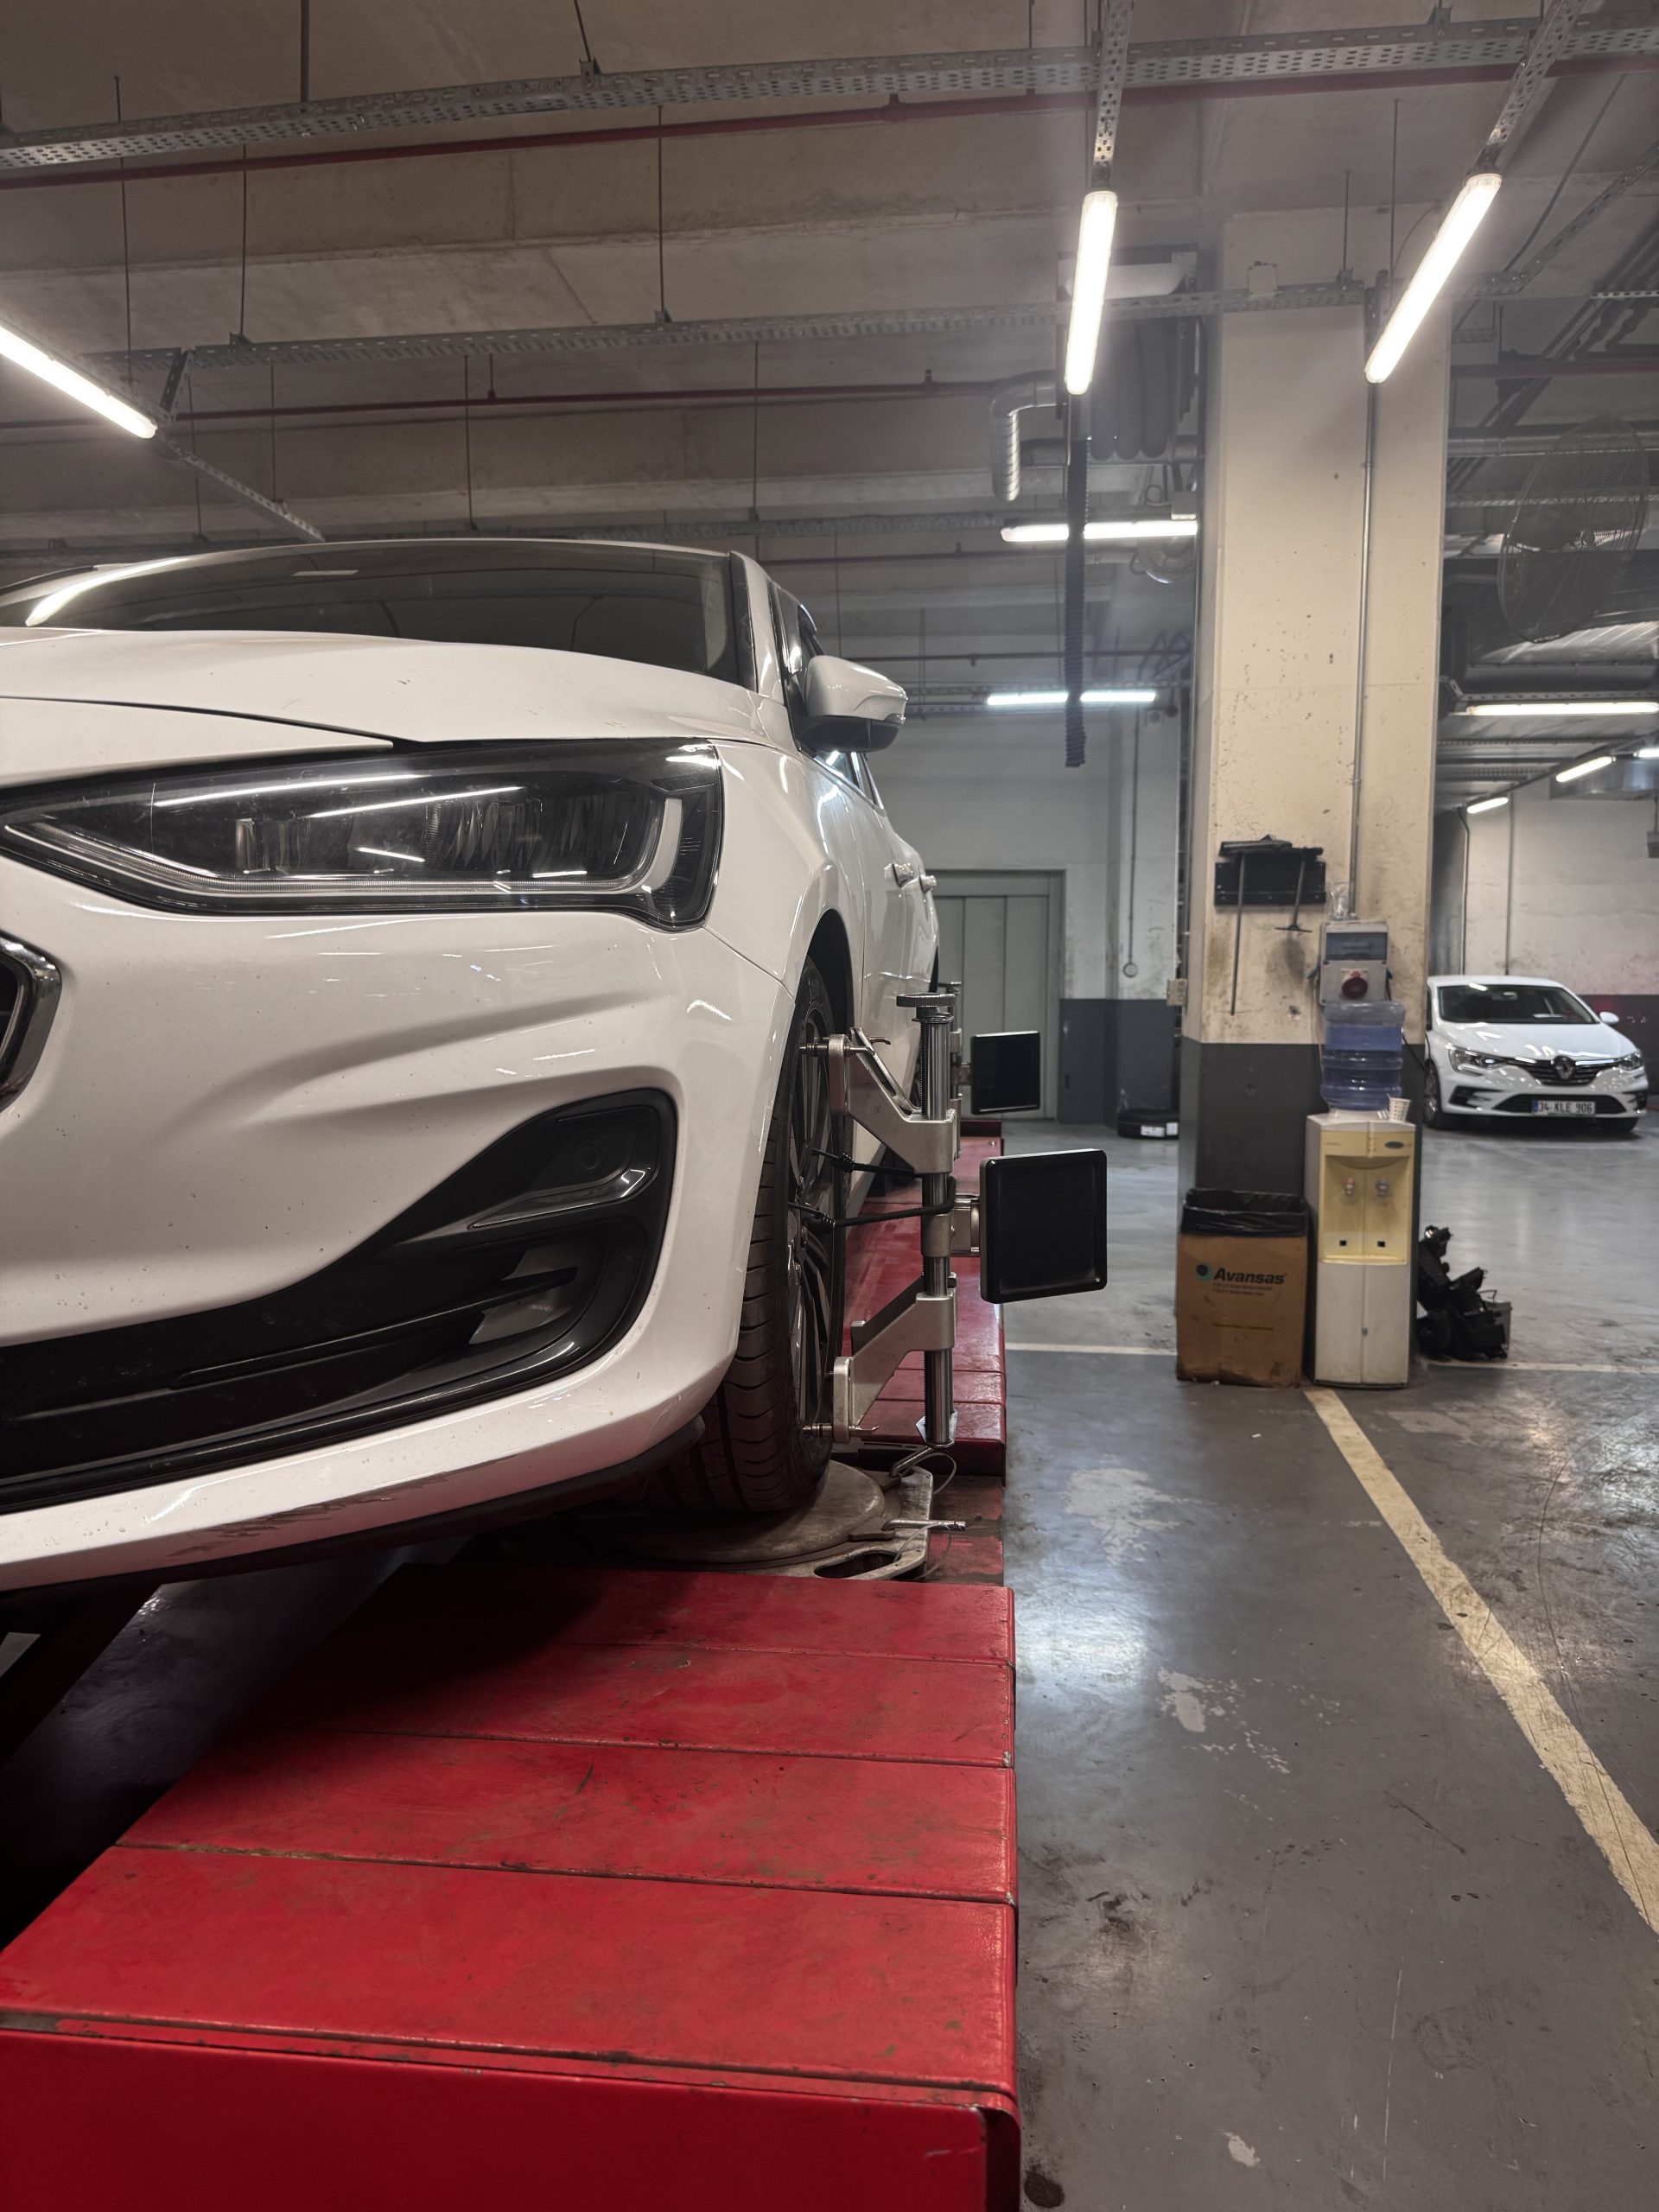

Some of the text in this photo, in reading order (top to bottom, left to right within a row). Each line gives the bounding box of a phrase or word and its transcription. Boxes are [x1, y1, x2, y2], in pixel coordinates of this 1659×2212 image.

[1538, 1102, 1548, 1112] 34
[1554, 1102, 1572, 1114] KLE
[1213, 1268, 1285, 1285] Avansas
